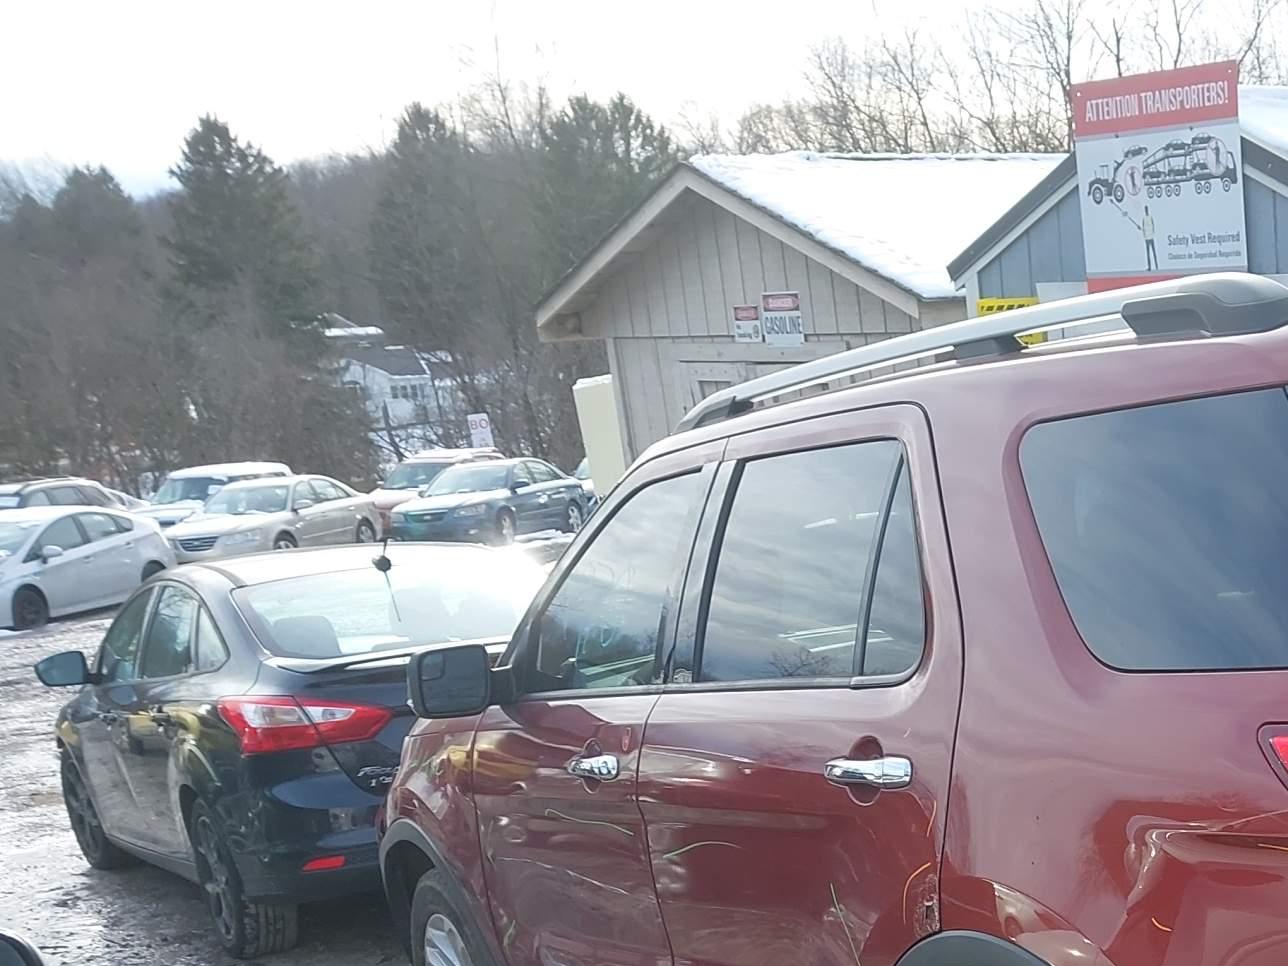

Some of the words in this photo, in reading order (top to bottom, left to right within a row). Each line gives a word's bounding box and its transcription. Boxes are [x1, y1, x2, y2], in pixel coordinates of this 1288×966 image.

[1085, 94, 1139, 122] ATTENTION
[1140, 80, 1229, 115] TRANSPORTERS!
[1167, 234, 1189, 248] Safety
[1190, 232, 1206, 245] Vest
[1207, 231, 1240, 247] Required
[764, 315, 802, 335] GASOLINE
